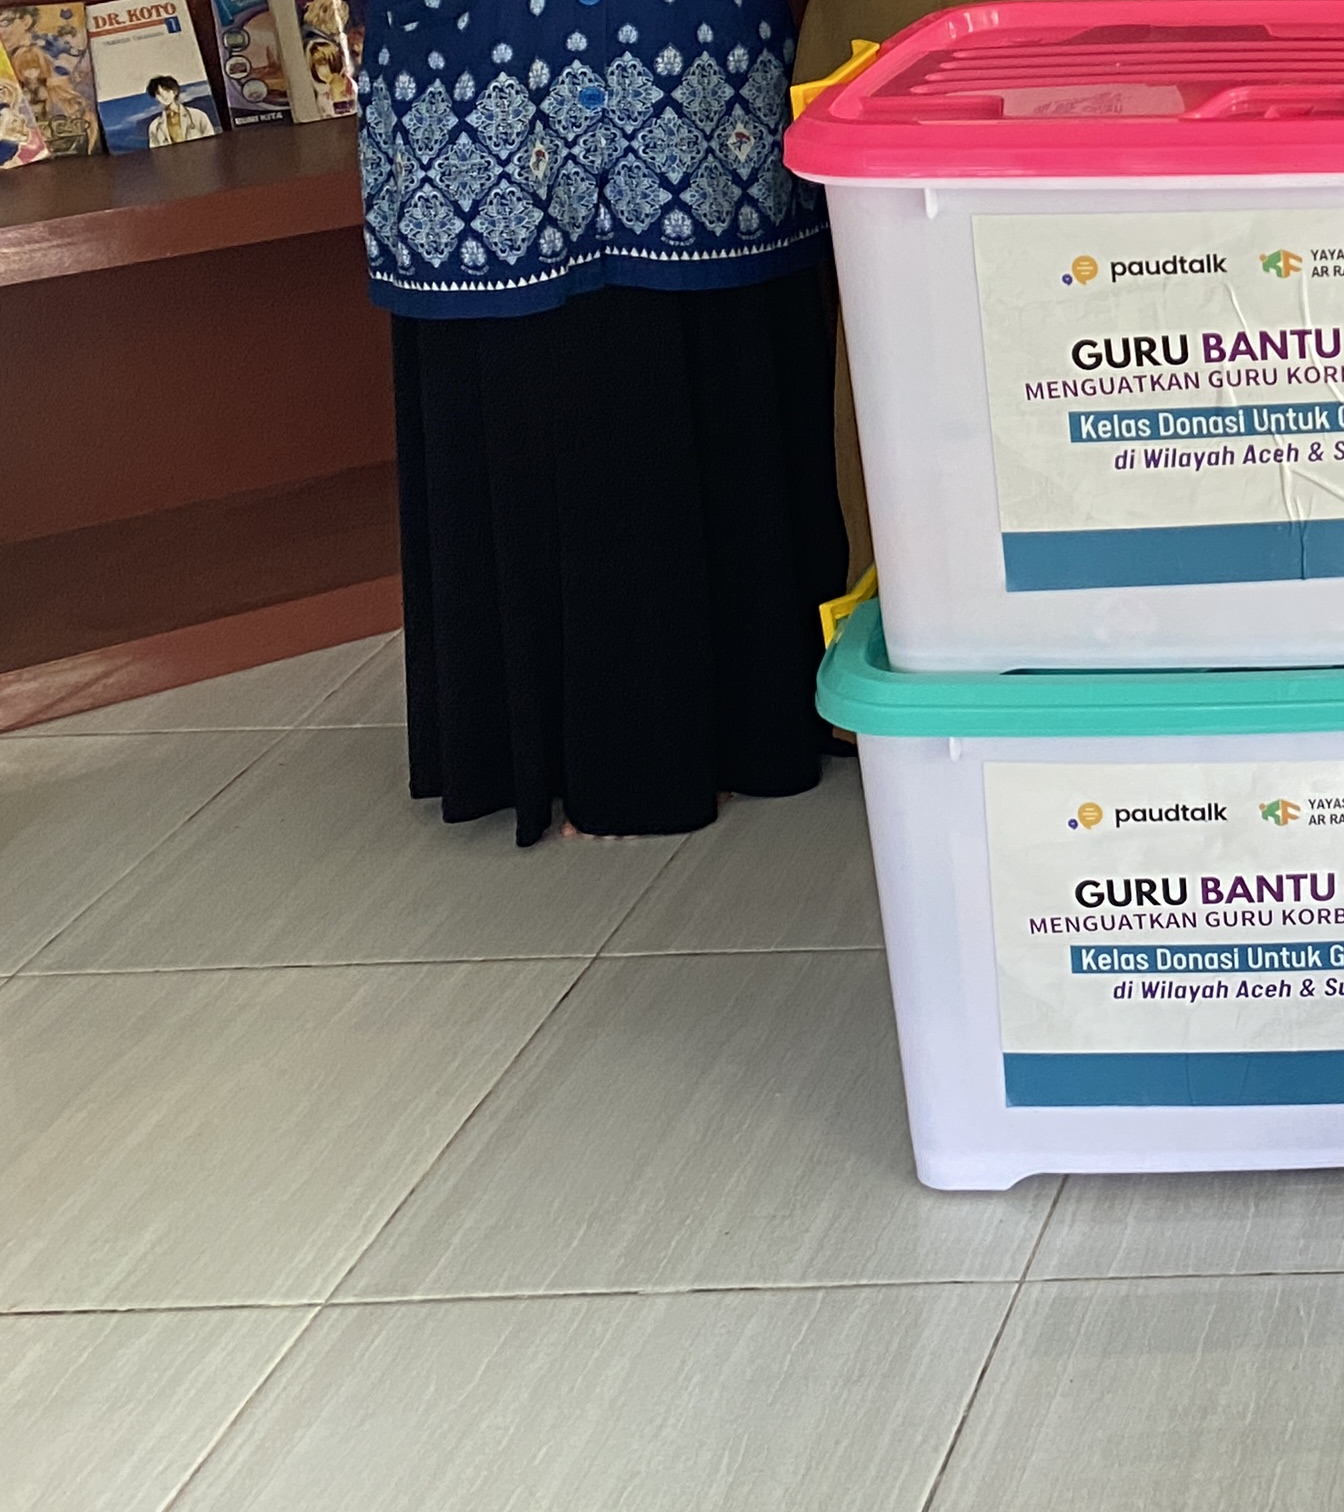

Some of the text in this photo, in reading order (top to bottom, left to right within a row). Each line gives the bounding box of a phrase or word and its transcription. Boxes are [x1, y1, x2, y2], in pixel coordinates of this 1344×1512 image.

[92, 2, 177, 29] DR. KOTO
[1111, 253, 1227, 283] paudtalk
[1071, 334, 1189, 370] GURU
[1203, 327, 1341, 363] BANTU
[1025, 371, 1200, 401] MENGUATKAN
[1207, 368, 1279, 388] GURU
[1115, 802, 1228, 829] paudtalk
[1074, 878, 1188, 908] GURU
[1200, 873, 1336, 904] BANTU
